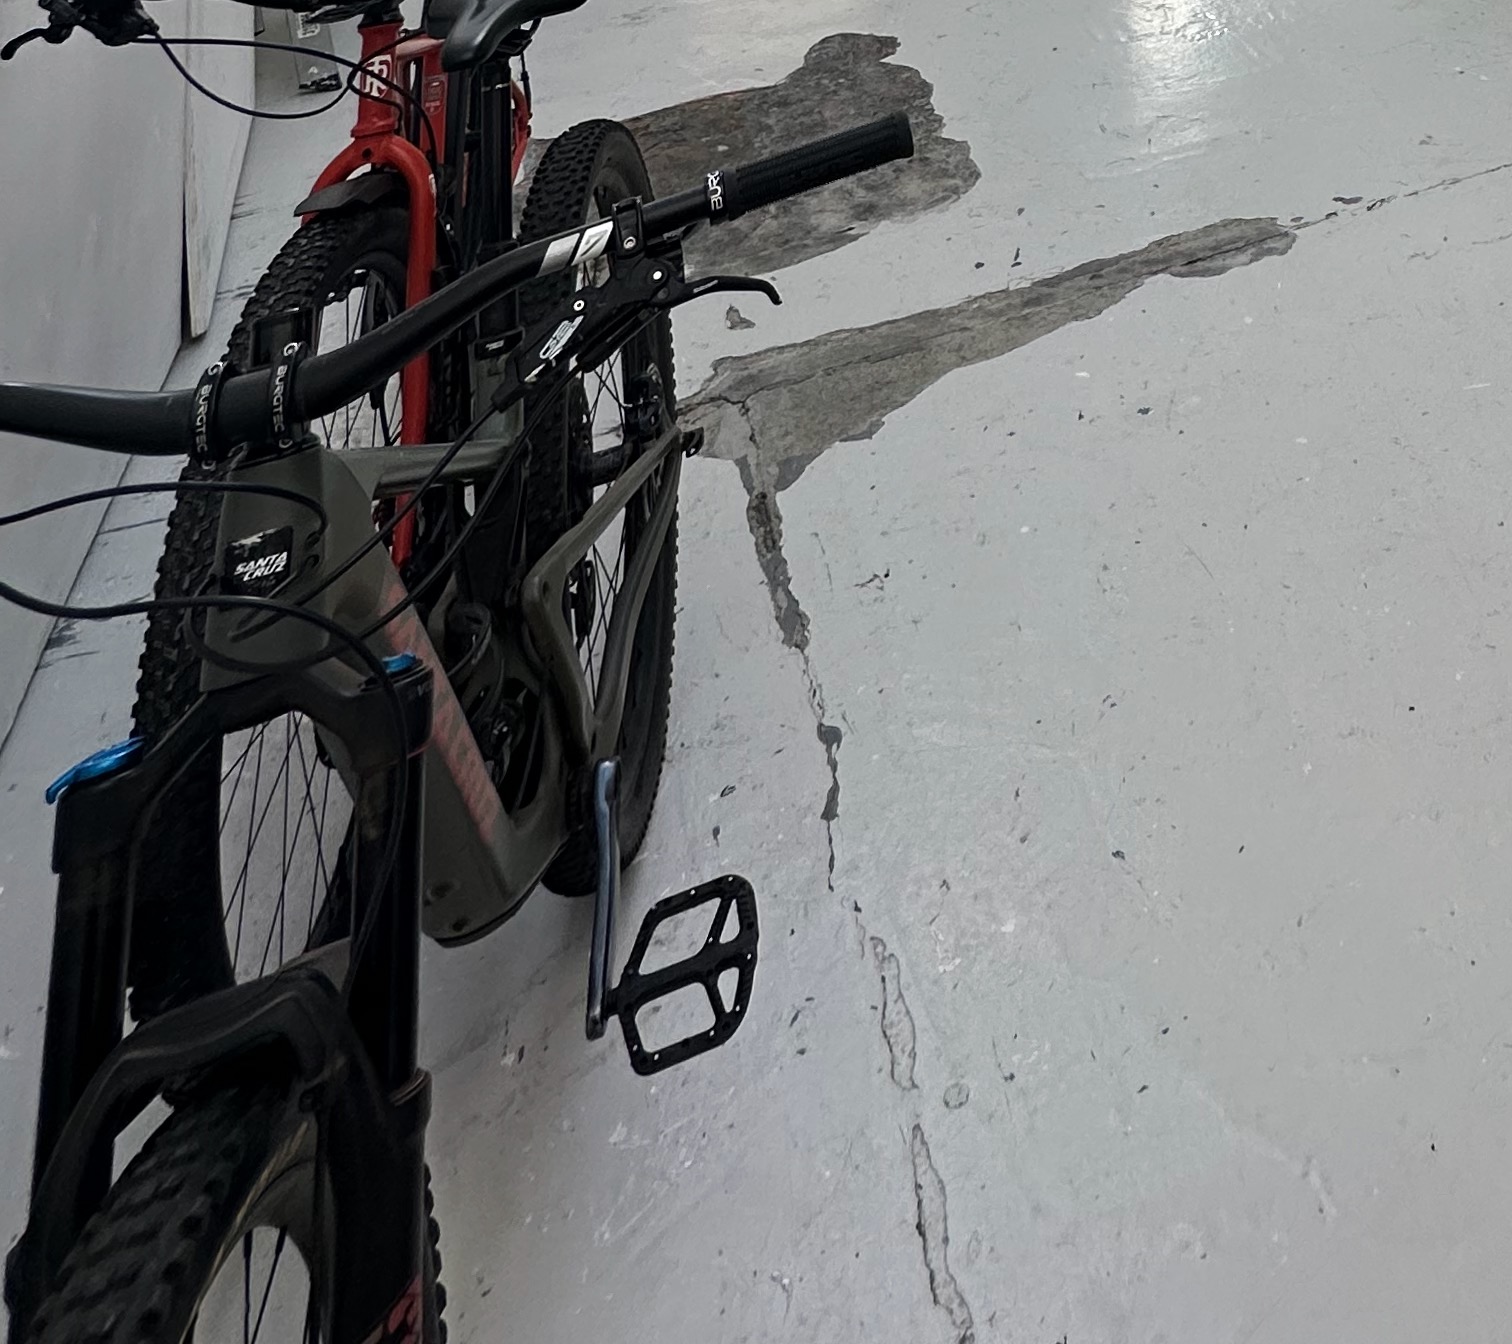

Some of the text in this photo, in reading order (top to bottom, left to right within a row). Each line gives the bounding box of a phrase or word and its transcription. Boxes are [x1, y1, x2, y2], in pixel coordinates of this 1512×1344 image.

[194, 384, 213, 453] BURGTEC
[271, 364, 288, 433] BURGTEC
[233, 551, 288, 576] SANTA
[242, 561, 288, 582] CRUZ
